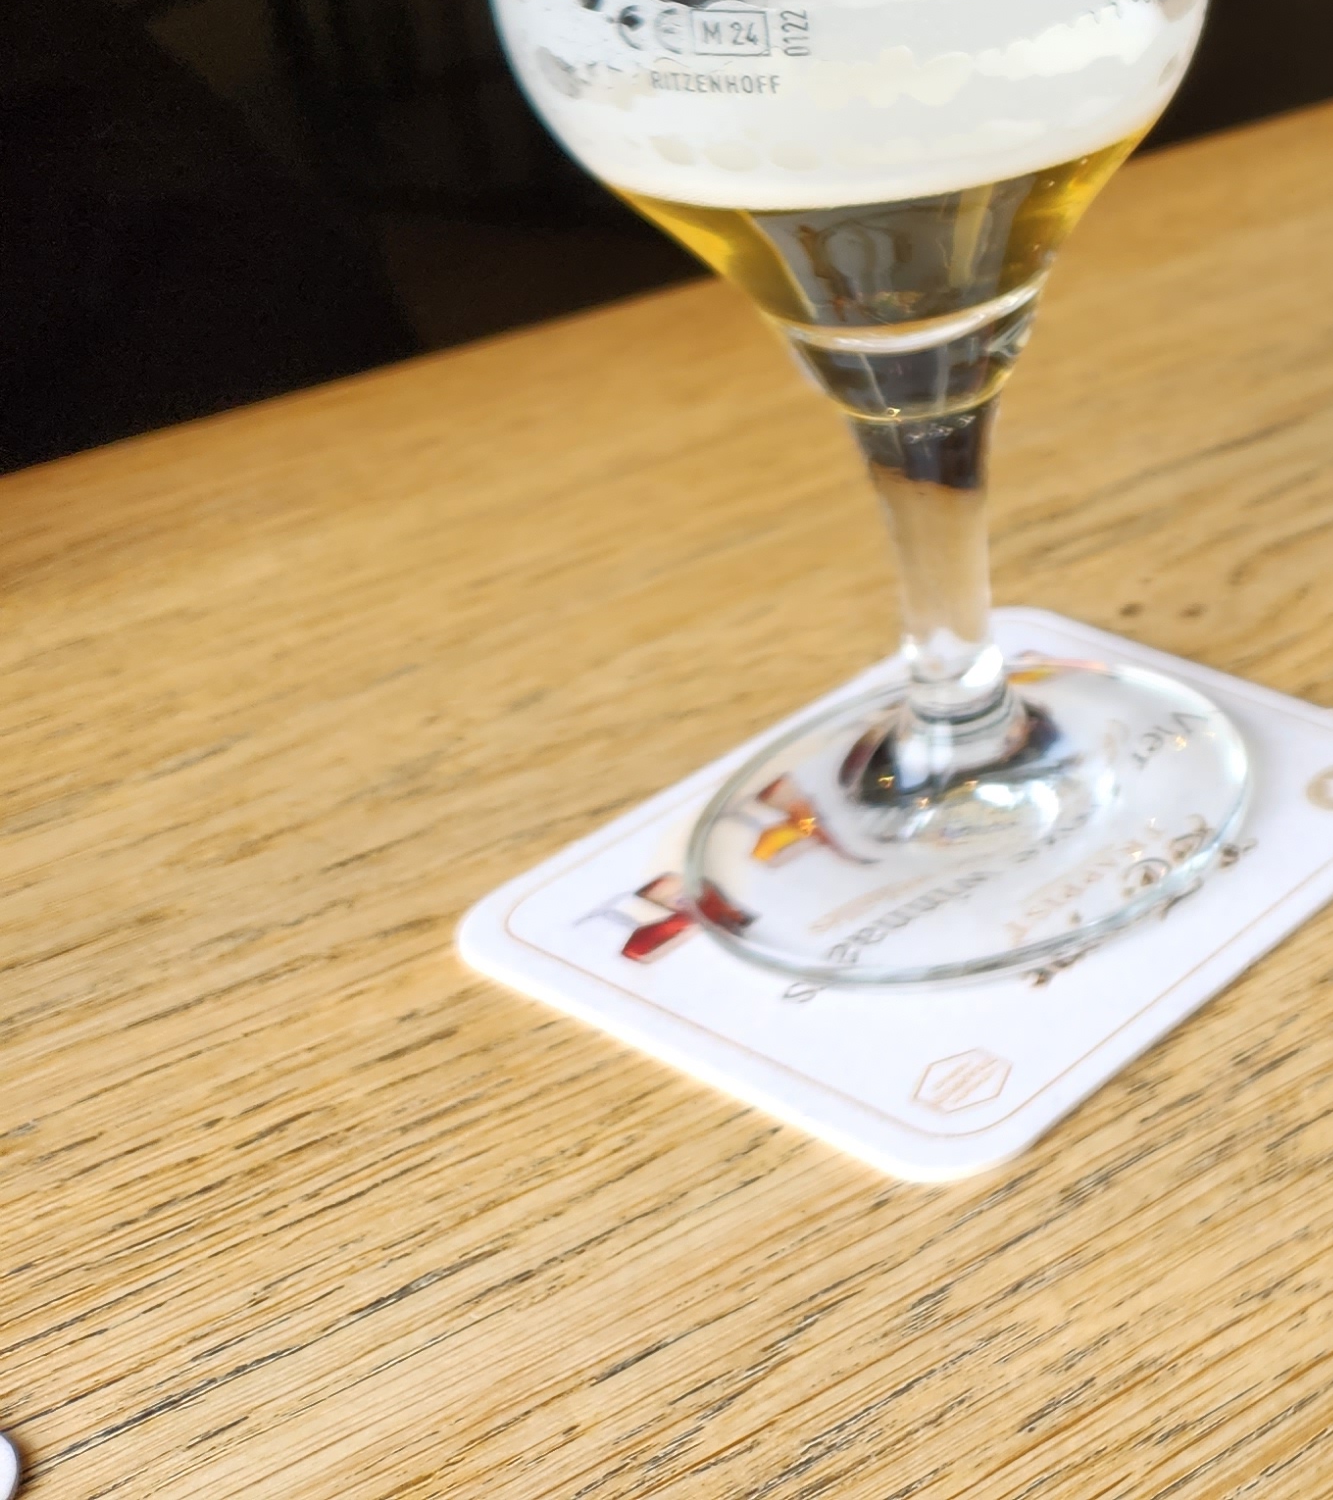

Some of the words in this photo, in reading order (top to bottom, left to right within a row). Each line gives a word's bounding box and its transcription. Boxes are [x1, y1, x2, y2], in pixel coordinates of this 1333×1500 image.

[730, 21, 759, 46] 24
[780, 9, 811, 57] 0122
[651, 70, 781, 95] RITZENHOFF
